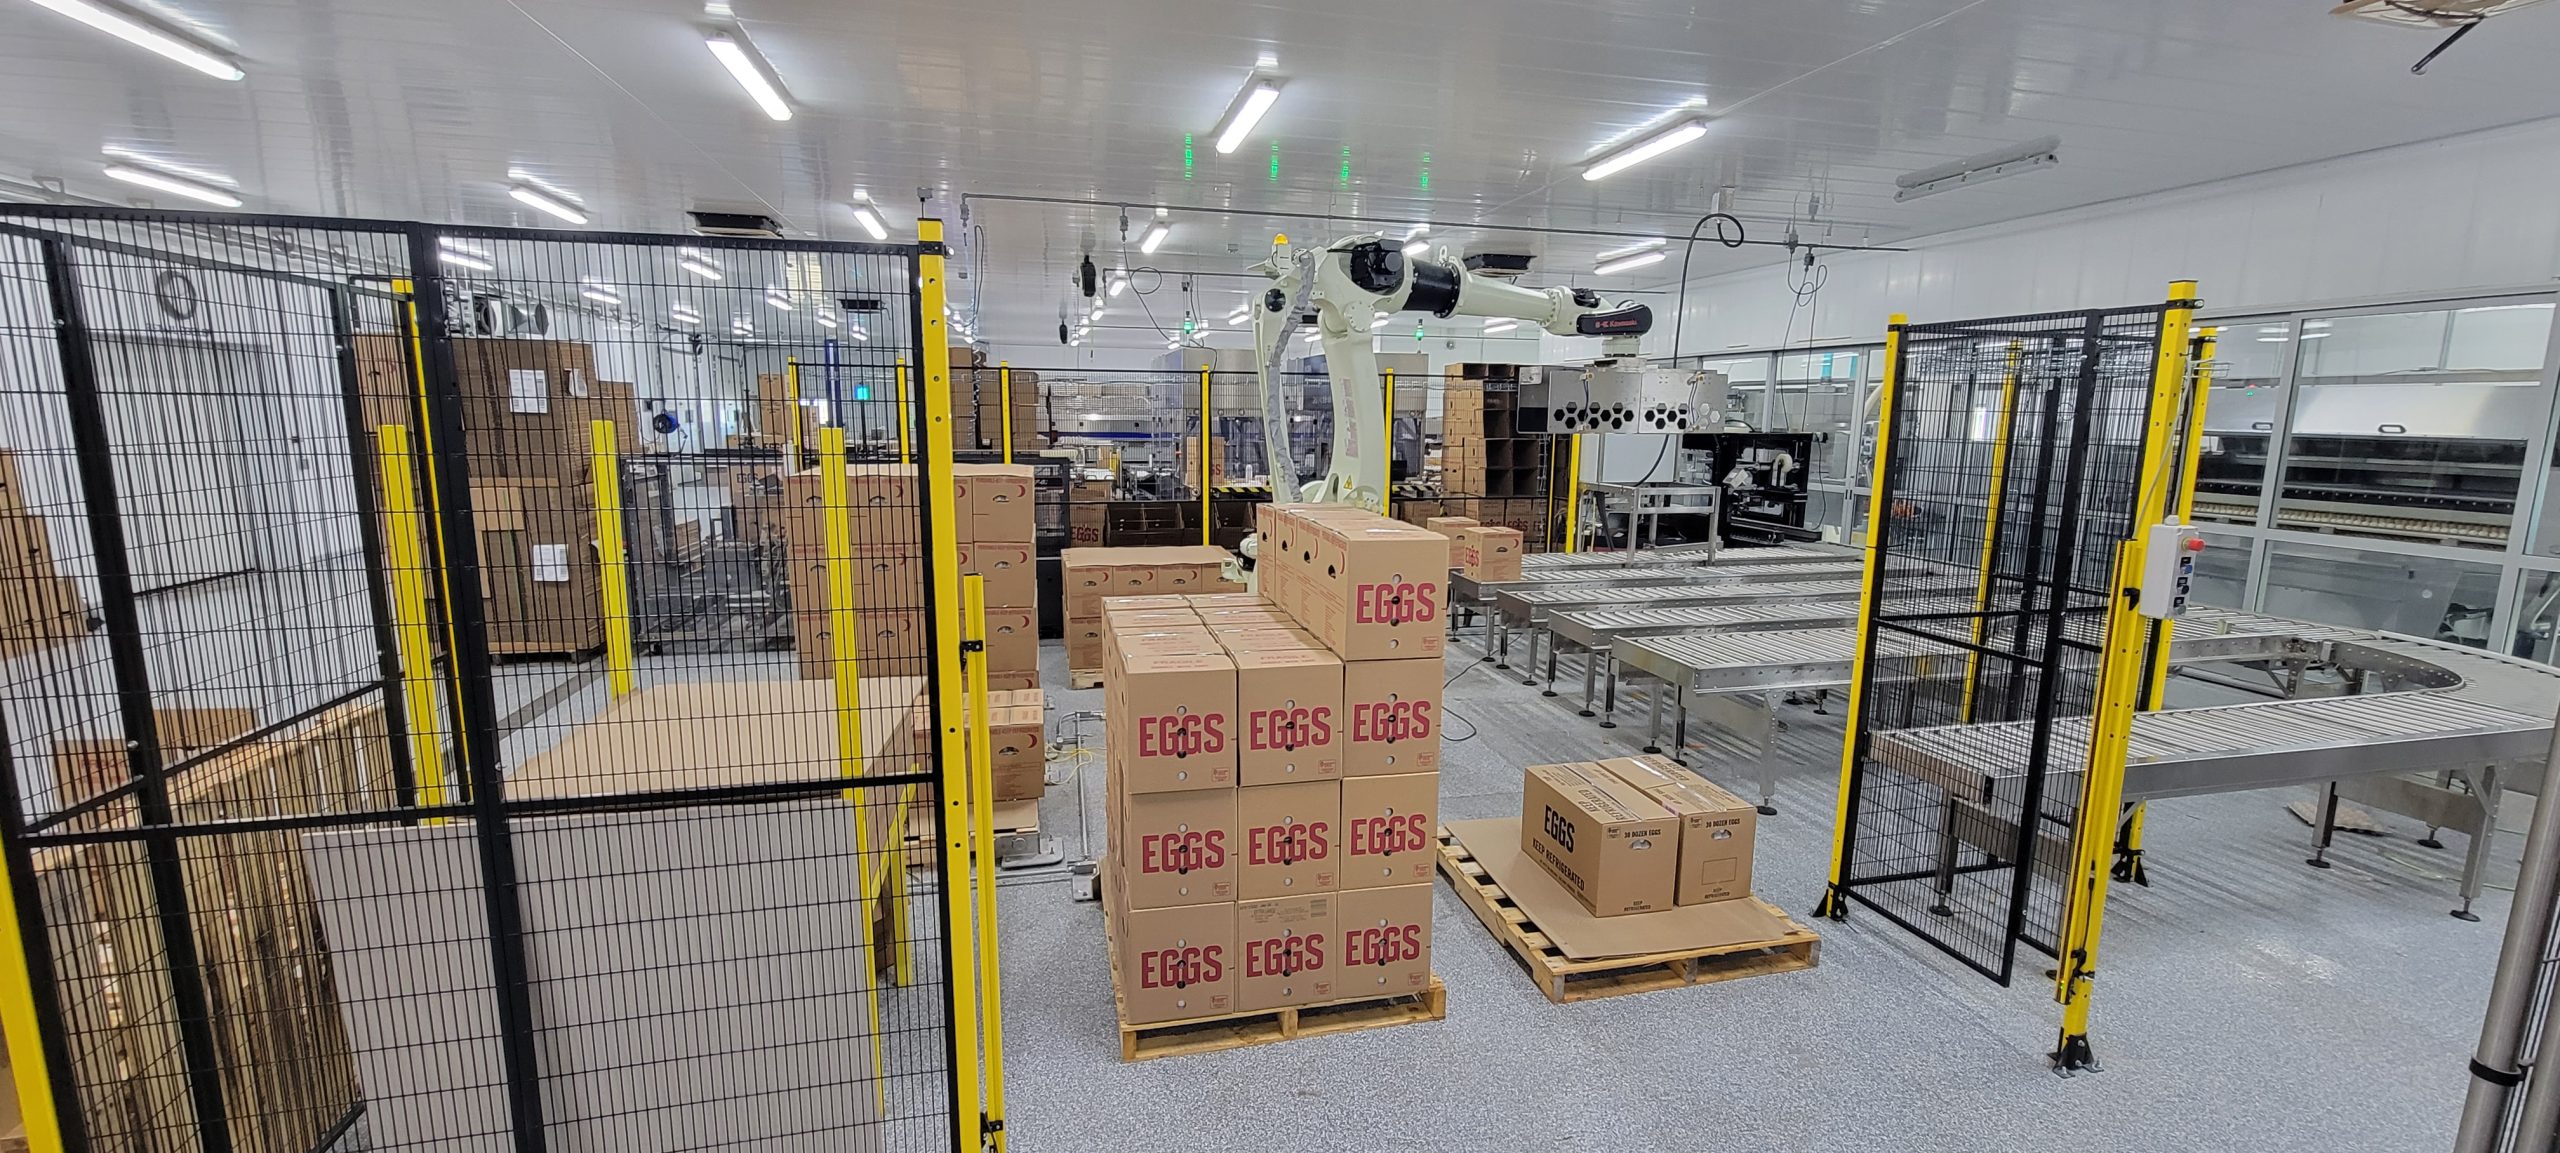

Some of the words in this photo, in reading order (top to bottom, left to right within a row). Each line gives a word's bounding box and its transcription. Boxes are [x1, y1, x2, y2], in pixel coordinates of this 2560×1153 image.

[1071, 526, 1099, 542] EGGS
[1356, 583, 1436, 624] EGGS
[1139, 713, 1225, 757] EGGS
[1250, 707, 1331, 750] EGGS
[1353, 701, 1430, 742] EGGS
[1249, 822, 1328, 865] EGGS
[1351, 813, 1427, 856] EGGS
[1544, 804, 1576, 854] EGGS
[1632, 830, 1648, 838] DOZEN
[1729, 818, 1741, 826] EGGS
[1143, 832, 1225, 873] EGGS
[1532, 837, 1545, 855] KEEP
[1546, 850, 1585, 892] REFRIGERATED
[1246, 934, 1324, 977] EGGS
[1345, 925, 1420, 966] EGGS
[1141, 946, 1222, 989] EGGS
